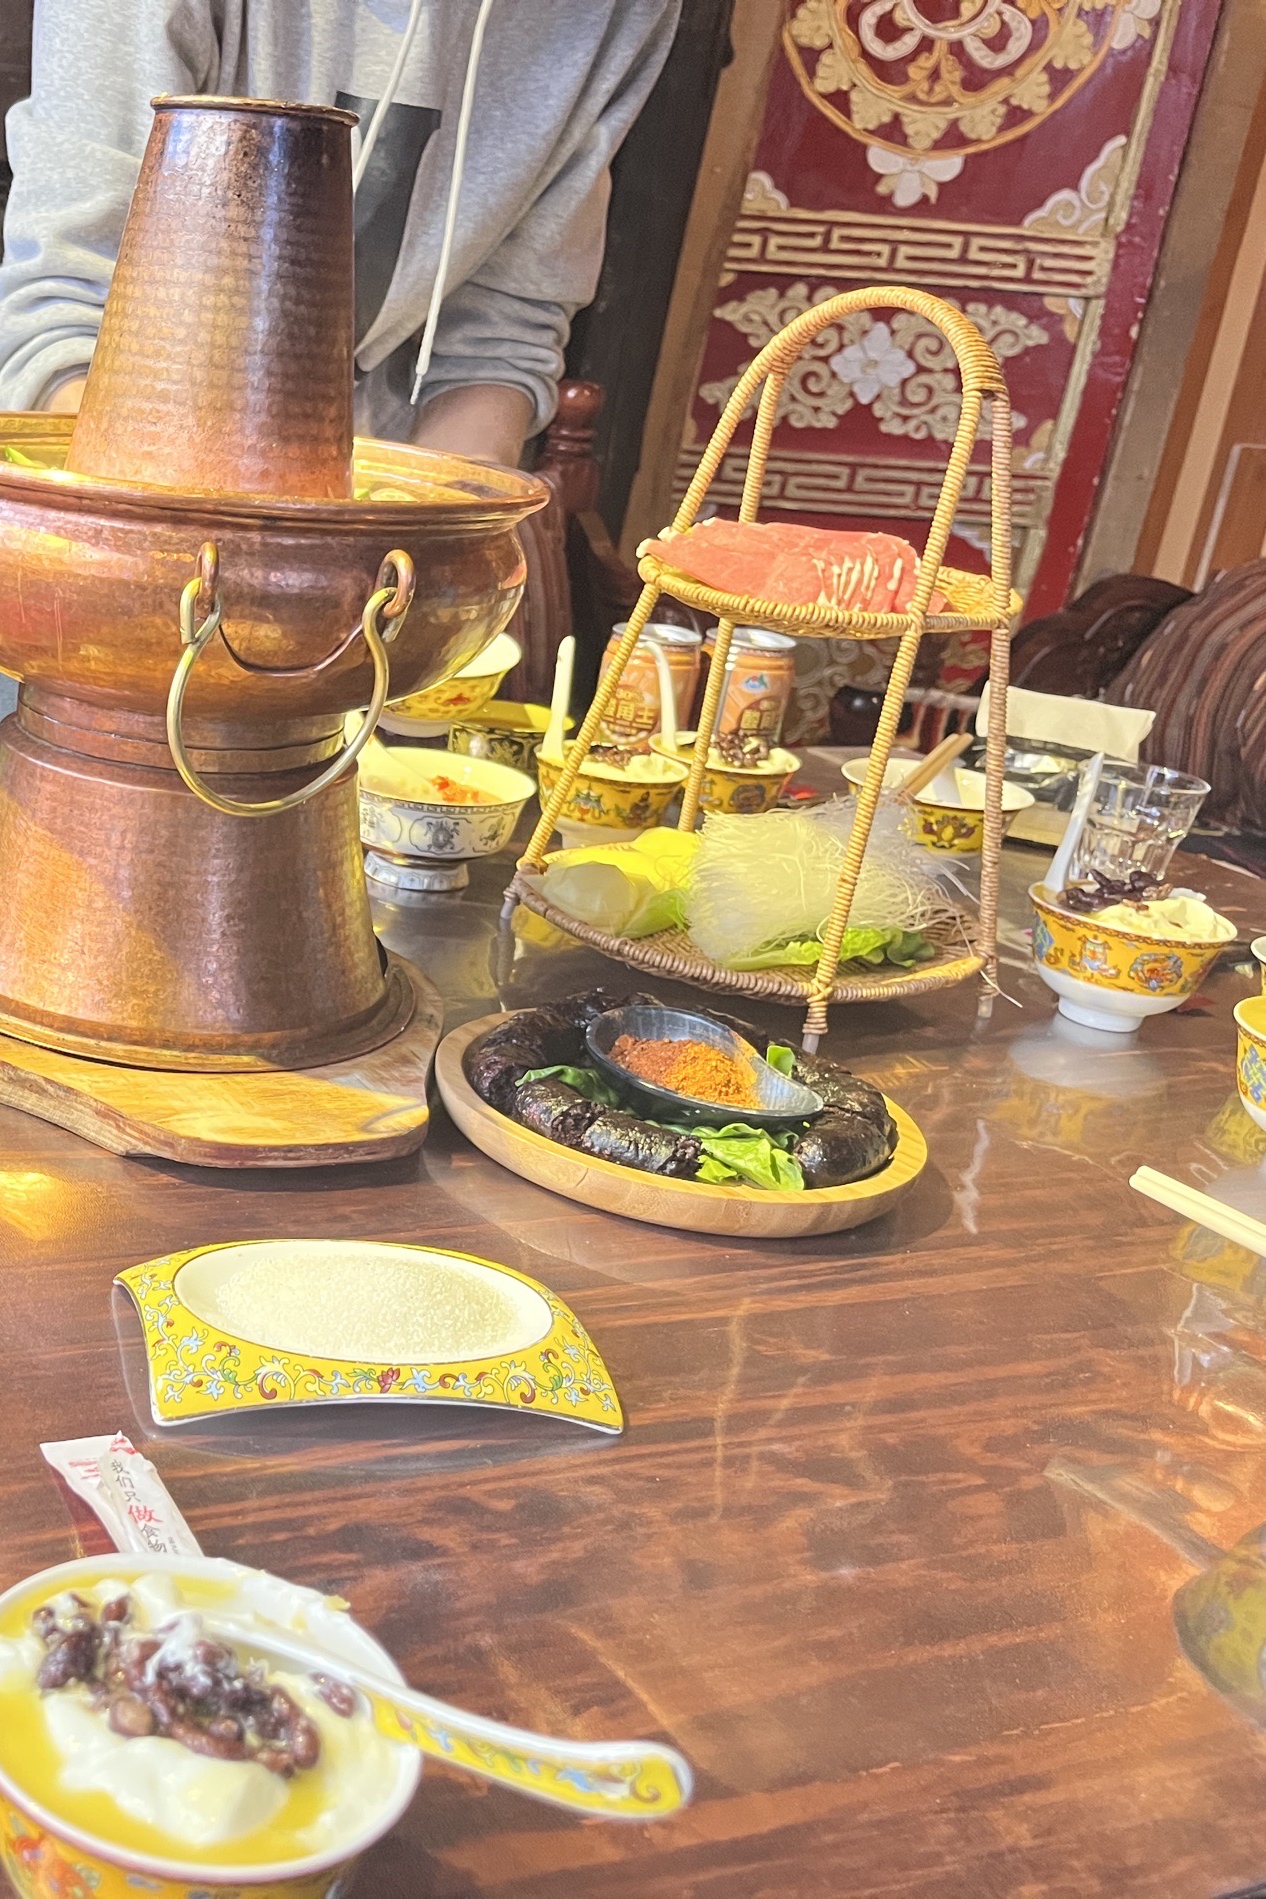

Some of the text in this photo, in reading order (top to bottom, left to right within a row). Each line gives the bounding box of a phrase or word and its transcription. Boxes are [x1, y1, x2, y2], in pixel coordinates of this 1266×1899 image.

[110, 1459, 167, 1554] 我们只做食物
